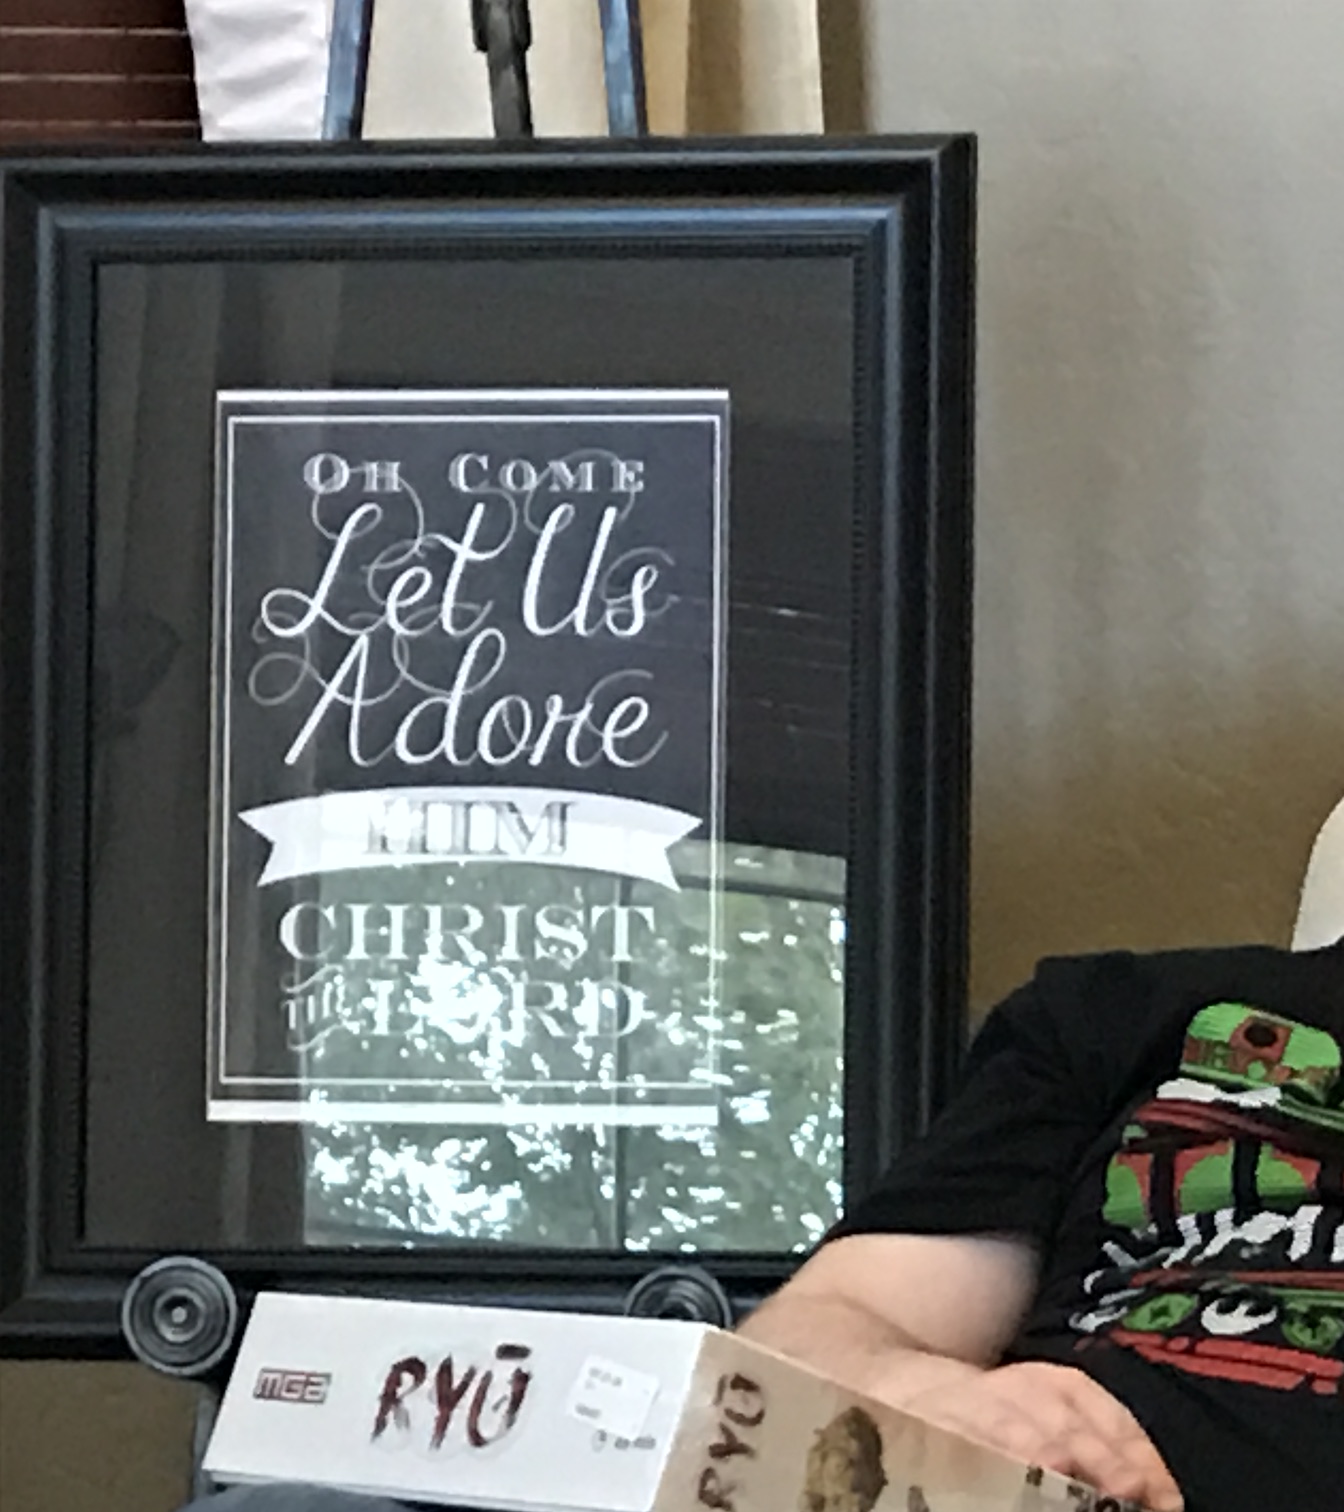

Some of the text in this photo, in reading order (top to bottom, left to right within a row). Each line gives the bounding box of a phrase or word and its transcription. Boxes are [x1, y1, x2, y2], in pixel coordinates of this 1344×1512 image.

[260, 501, 664, 638] Let Us
[284, 628, 669, 768] Adore
[279, 902, 656, 965] CHRIST
